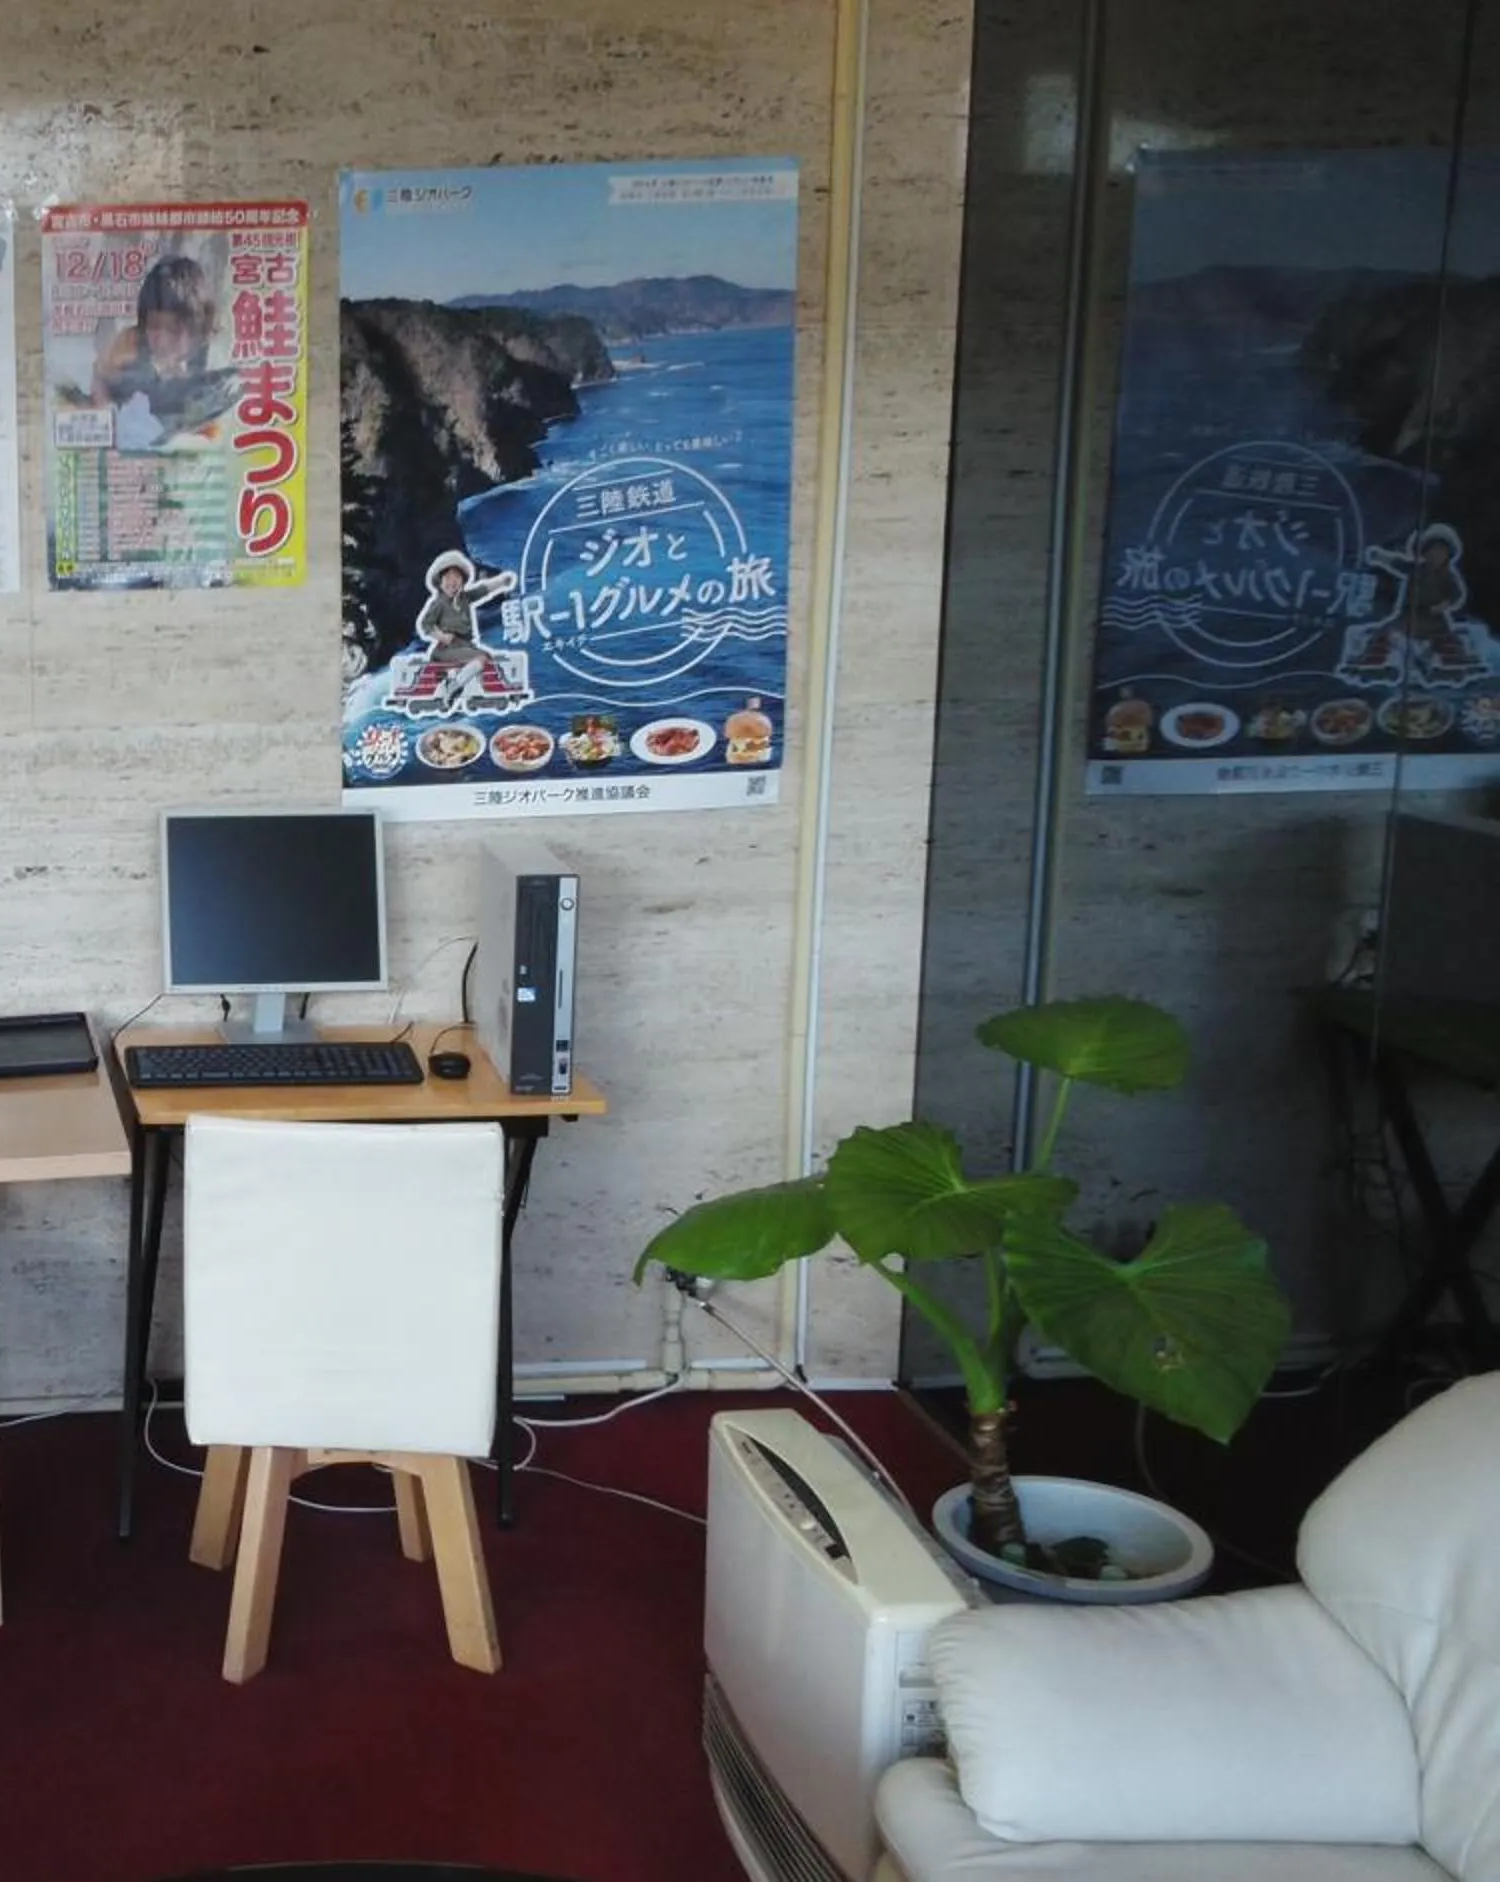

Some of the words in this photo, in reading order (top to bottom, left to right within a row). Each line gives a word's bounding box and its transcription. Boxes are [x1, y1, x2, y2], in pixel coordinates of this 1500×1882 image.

[576, 478, 677, 519] 三陸鉄道
[579, 524, 688, 577] ジオと
